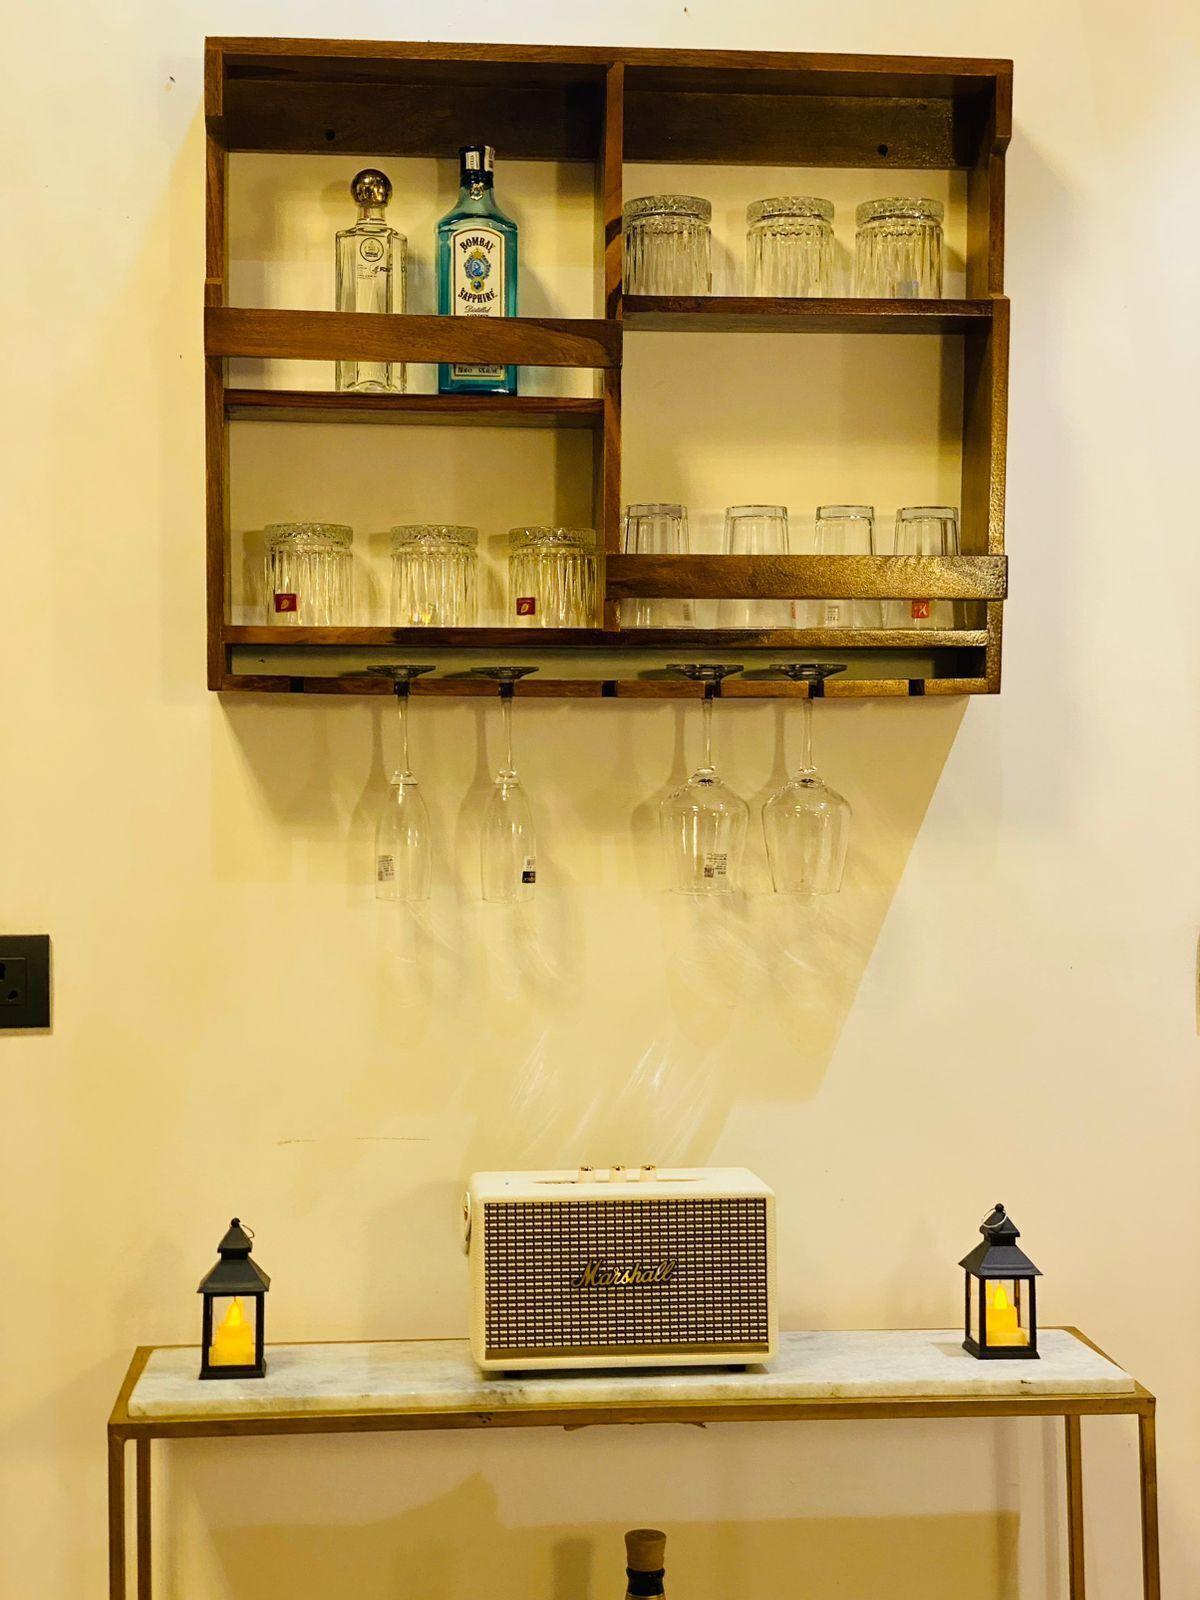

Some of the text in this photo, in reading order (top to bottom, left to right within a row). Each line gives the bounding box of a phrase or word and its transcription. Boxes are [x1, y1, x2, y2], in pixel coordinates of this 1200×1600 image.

[460, 237, 494, 253] BOMBAY
[458, 288, 496, 303] SAPPHIRE
[571, 1259, 675, 1287] Marshall
